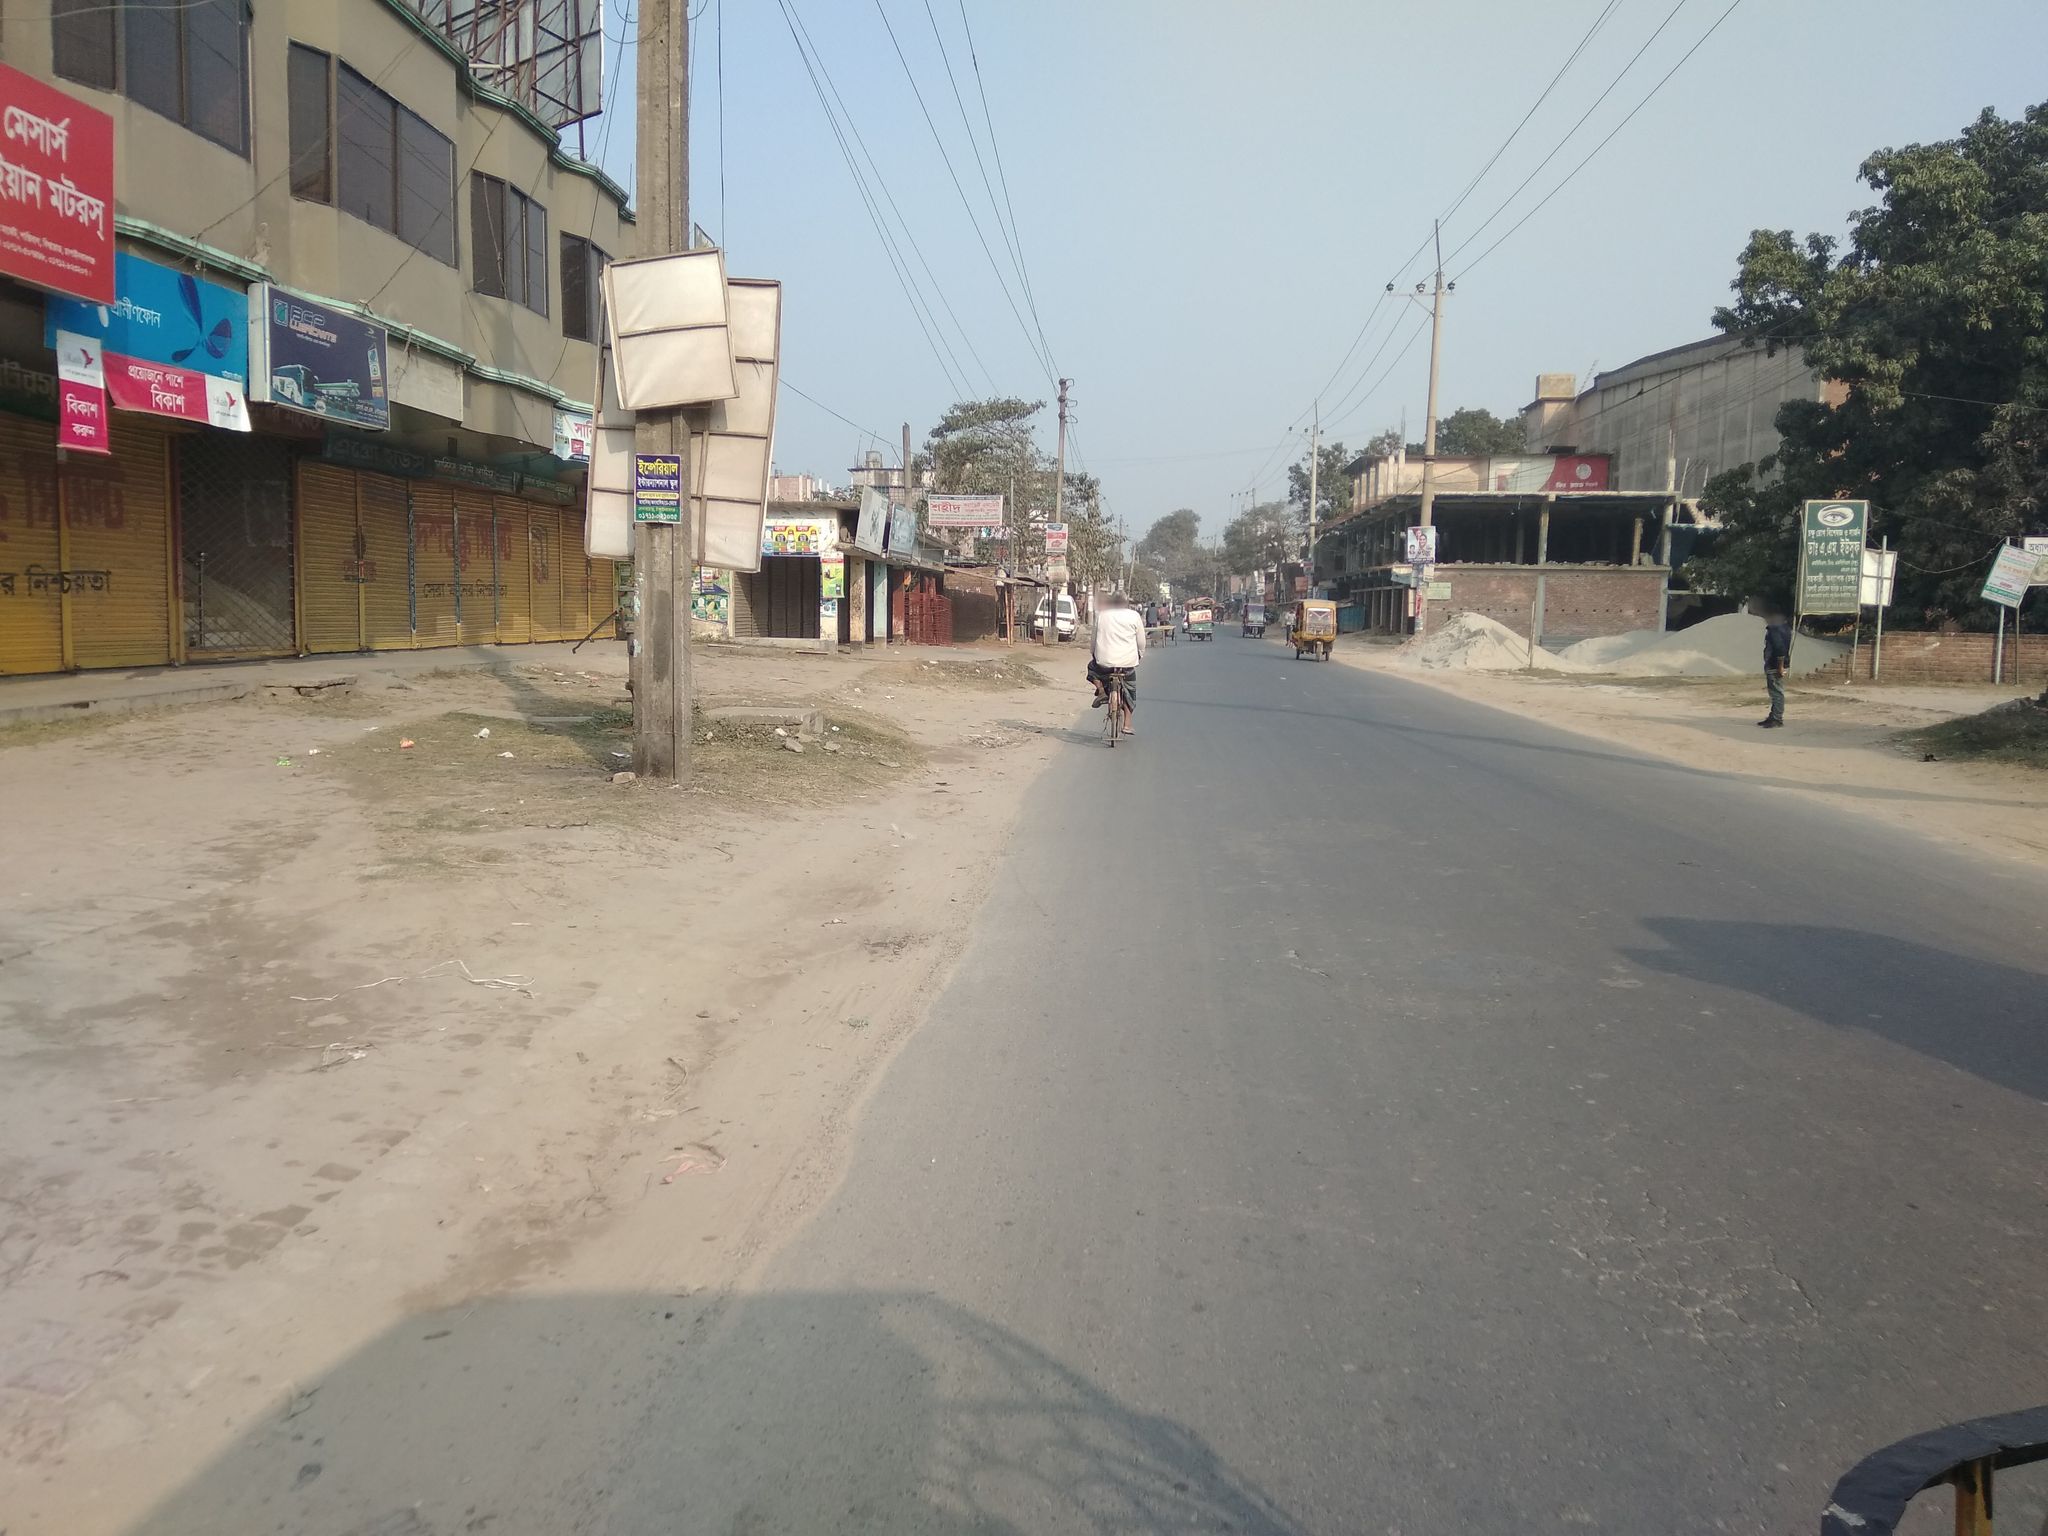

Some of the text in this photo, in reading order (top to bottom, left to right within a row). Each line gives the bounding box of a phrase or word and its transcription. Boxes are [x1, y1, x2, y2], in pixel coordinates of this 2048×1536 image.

[4, 106, 71, 163] মেসার্স
[46, 173, 105, 241] মটরস্
[128, 365, 184, 388] প্রয়োজনে পাশে
[65, 393, 98, 418] বিকাশ
[150, 384, 185, 413] বিকাশ
